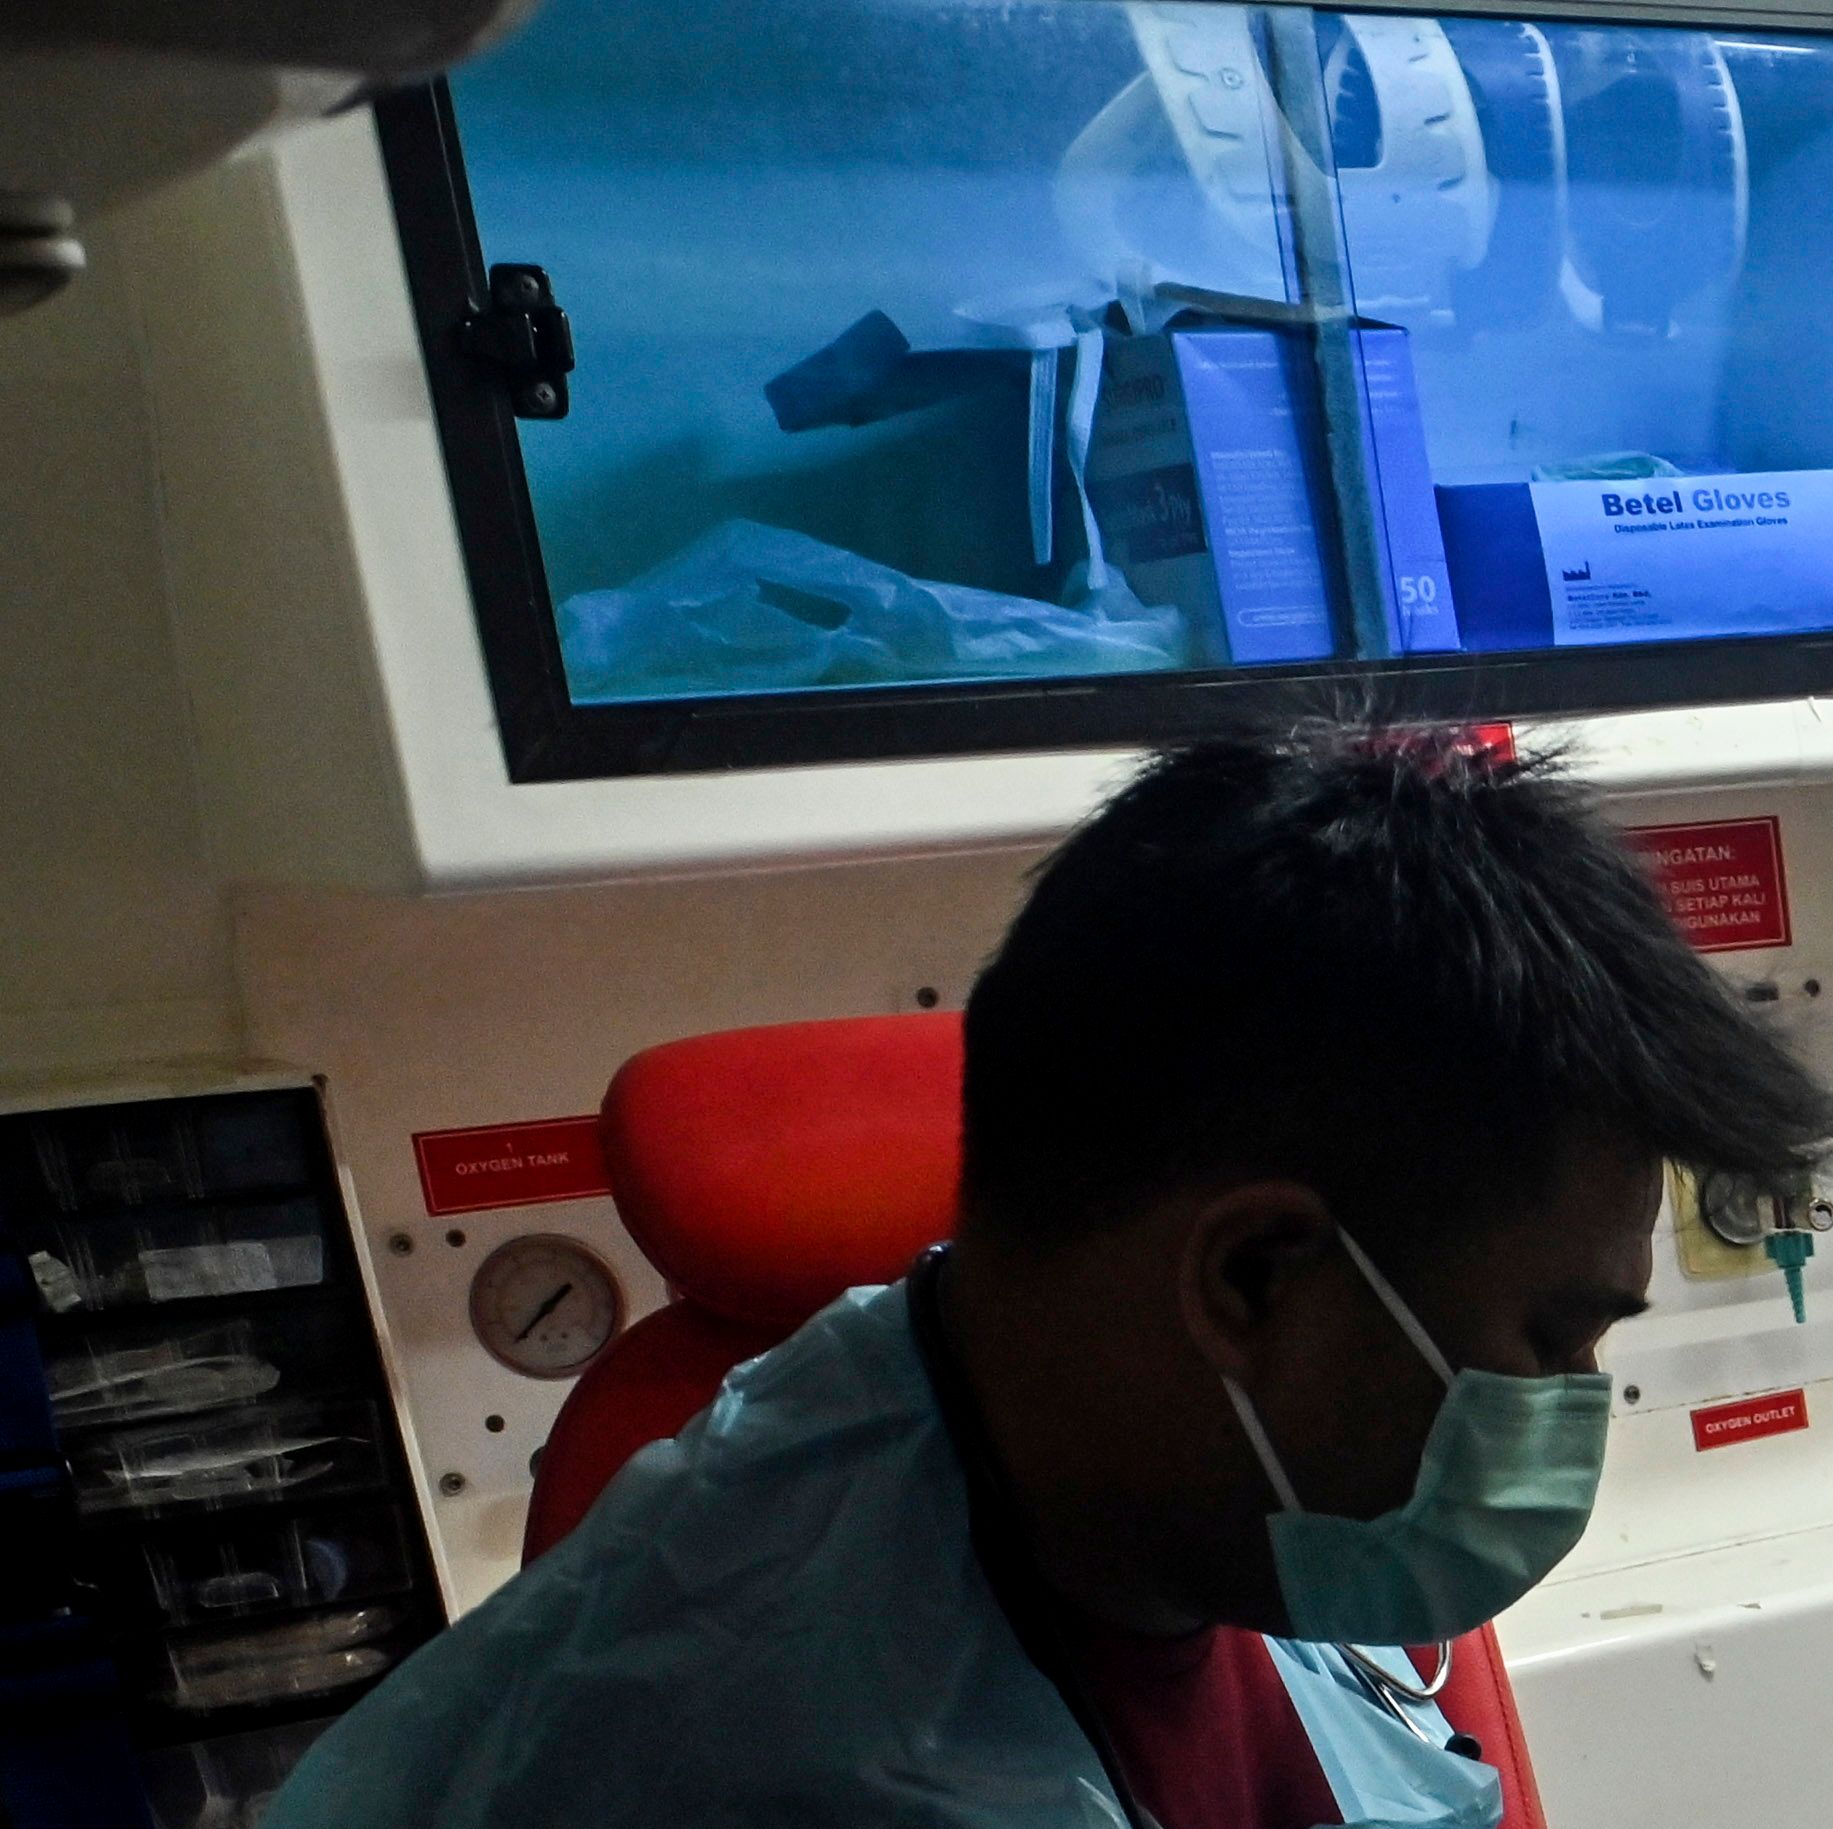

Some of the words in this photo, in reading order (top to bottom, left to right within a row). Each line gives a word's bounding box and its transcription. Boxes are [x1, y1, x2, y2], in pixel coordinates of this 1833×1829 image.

[1601, 490, 1683, 516] Betel
[1691, 488, 1791, 512] Gloves
[1614, 521, 1667, 534] Disposable
[1697, 517, 1754, 530] Examination
[1756, 515, 1788, 526] Gloves
[1401, 575, 1436, 603] 50
[1670, 877, 1704, 895] SUIS
[1708, 874, 1760, 890] UTAMA
[1678, 894, 1729, 912] SETIAP
[1732, 892, 1766, 907] KALI
[455, 1157, 523, 1176] OXYGEN
[528, 1151, 570, 1167] TANK
[1705, 1416, 1751, 1434] OXYGEN
[1753, 1405, 1795, 1424] OUTLET
